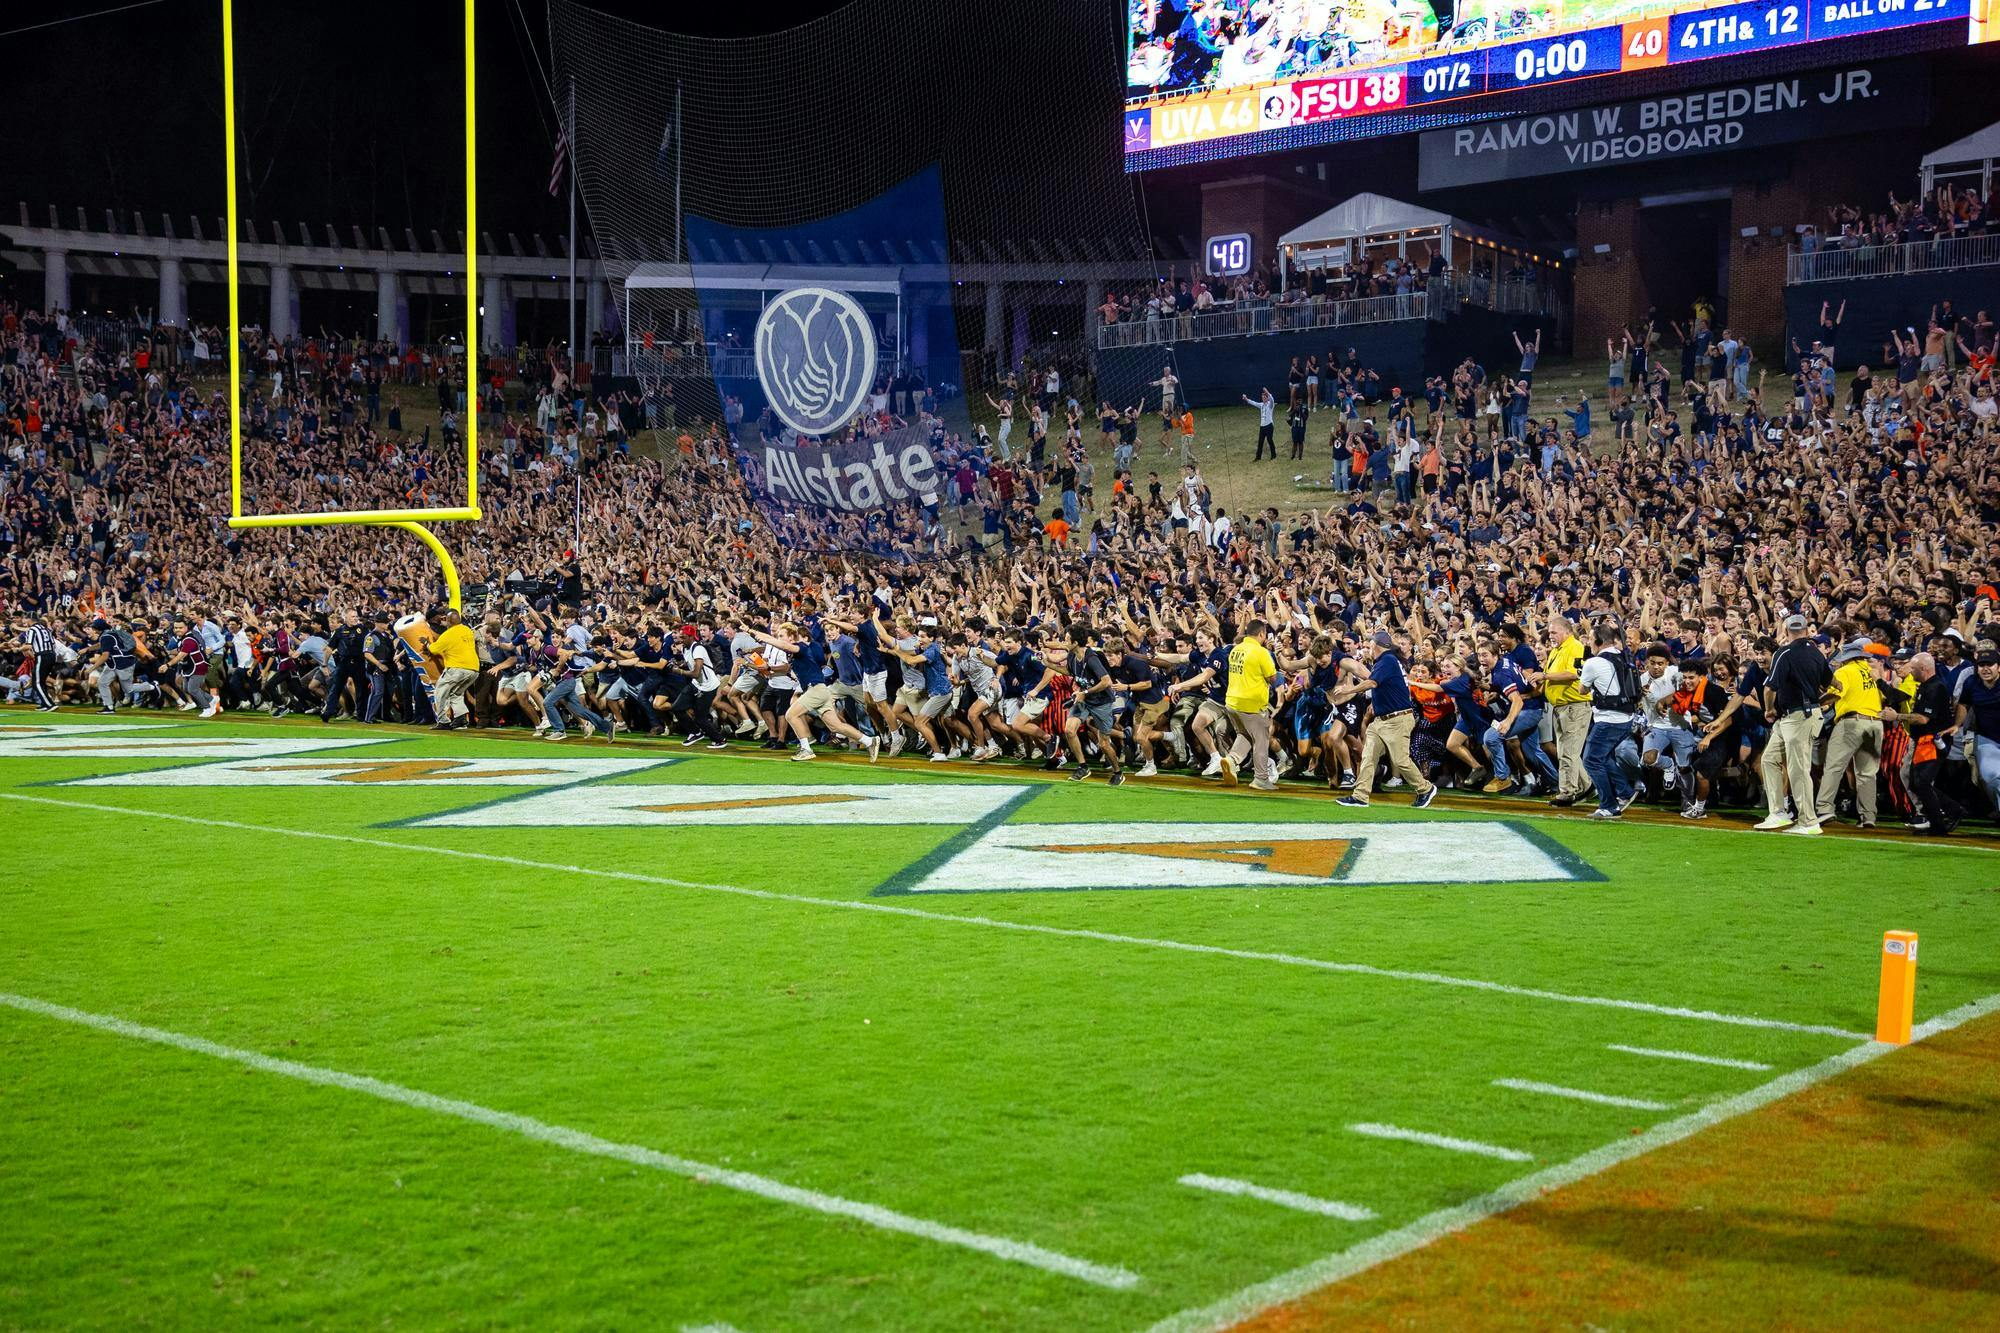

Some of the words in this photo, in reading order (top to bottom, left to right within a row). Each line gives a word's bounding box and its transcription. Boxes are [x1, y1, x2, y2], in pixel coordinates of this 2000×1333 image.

[1765, 6, 1798, 36] 12
[1824, 0, 1874, 23] BALL
[1628, 29, 1663, 58] 40
[1514, 39, 1587, 81] 0:00
[1423, 62, 1471, 93] OT/2
[1301, 79, 1359, 118] FSU
[1364, 72, 1400, 106] 38
[1161, 103, 1216, 139] UVA
[1219, 98, 1254, 130] 46
[1454, 112, 1579, 156] RAMON
[1592, 106, 1624, 136] W.
[1819, 69, 1880, 104] JR.
[1564, 121, 1744, 164] VIDEOBOARD
[1213, 240, 1244, 269] 40
[765, 442, 939, 511] Allstate
[62, 595, 72, 607] 18
[1213, 660, 1221, 669] 91
